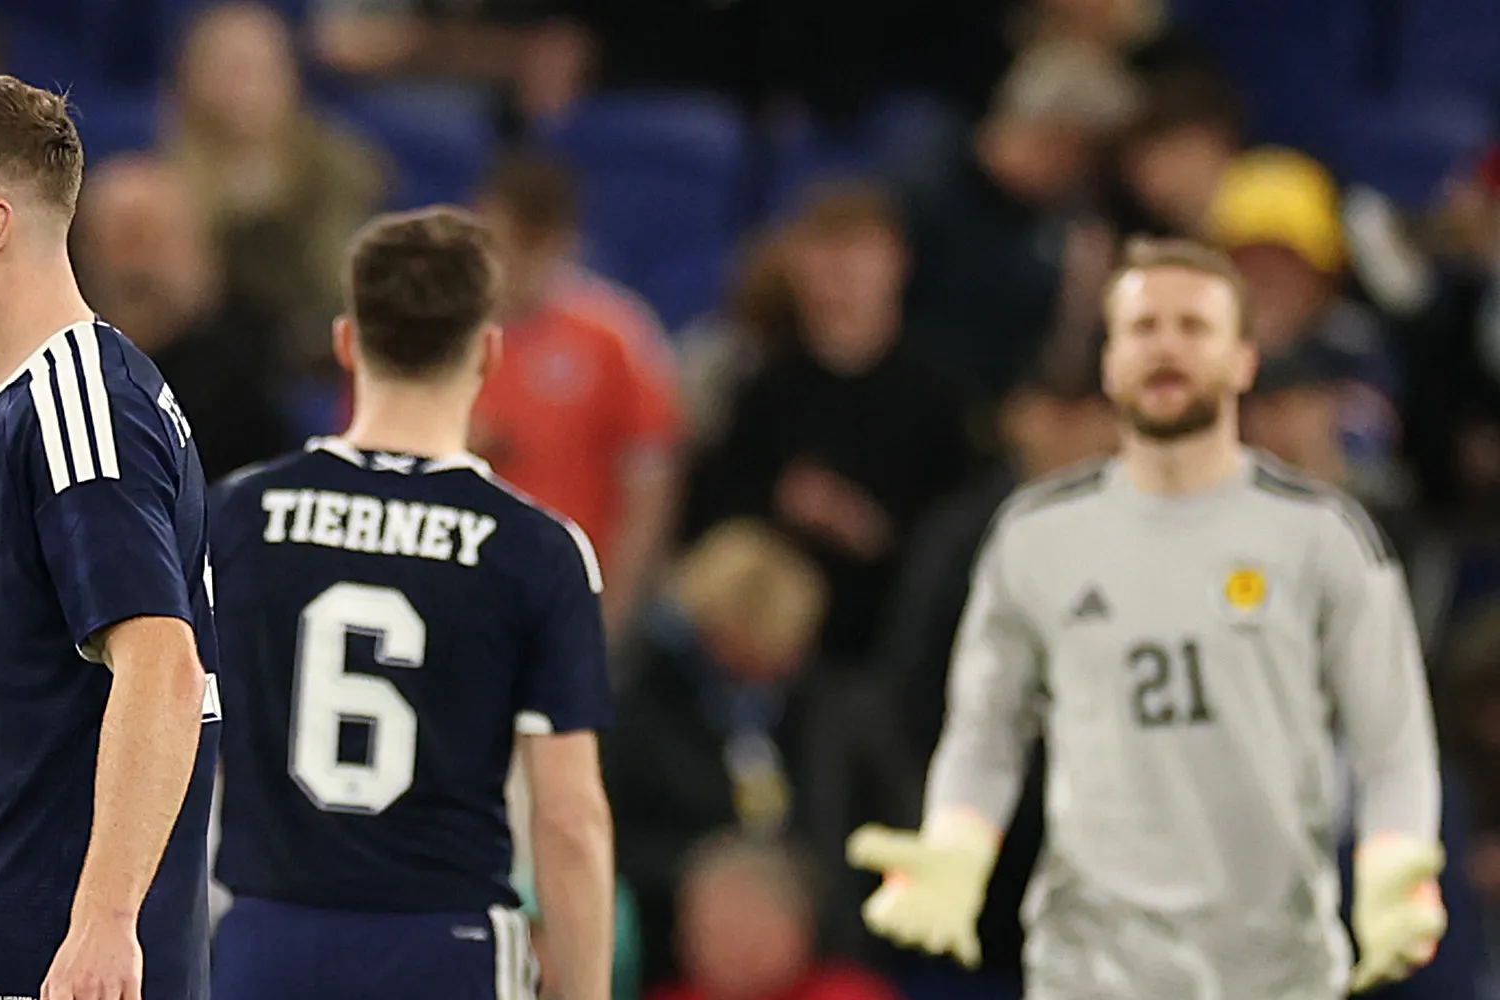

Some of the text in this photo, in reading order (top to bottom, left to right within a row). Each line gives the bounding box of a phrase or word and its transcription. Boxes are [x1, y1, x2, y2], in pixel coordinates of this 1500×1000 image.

[261, 488, 497, 566] TIERNEY
[288, 581, 427, 815] 6
[1127, 640, 1212, 728] 21
